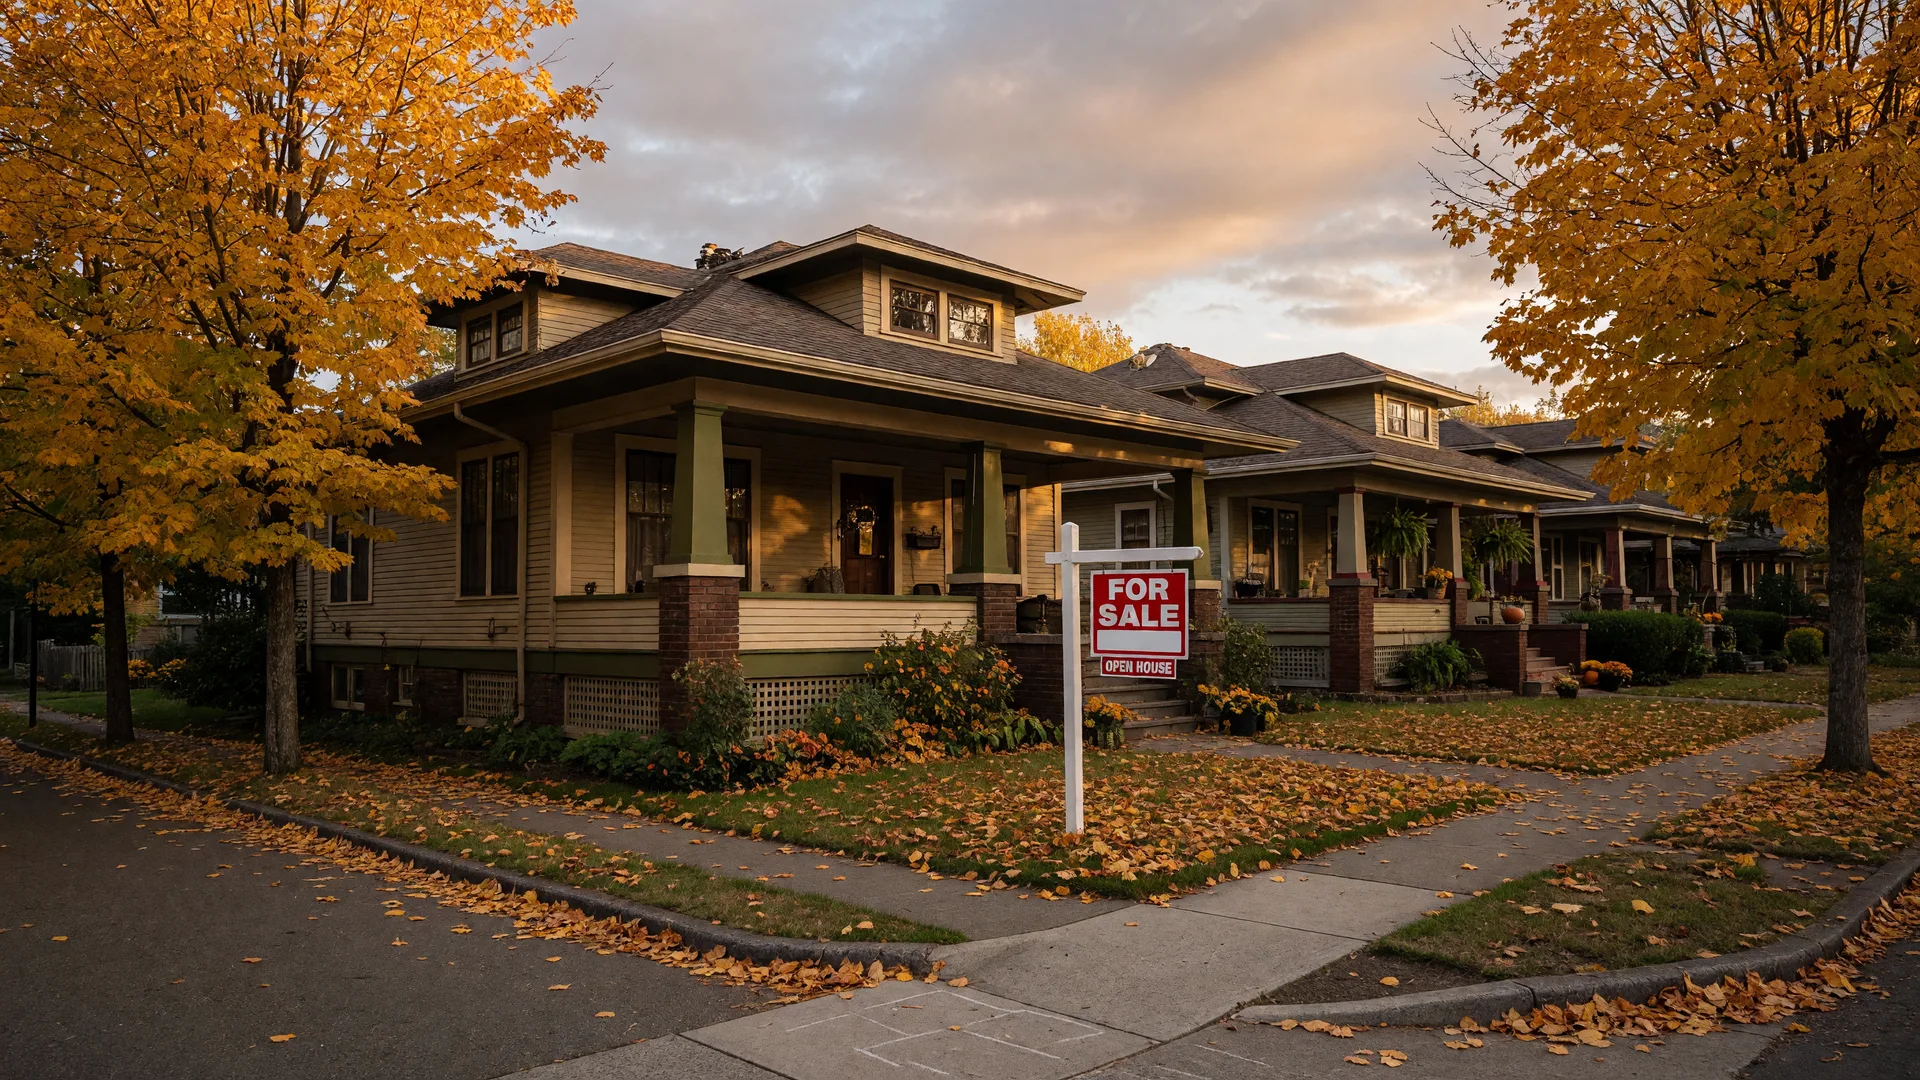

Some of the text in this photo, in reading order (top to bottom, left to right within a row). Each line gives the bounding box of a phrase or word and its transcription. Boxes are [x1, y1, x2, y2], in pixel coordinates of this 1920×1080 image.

[1108, 577, 1169, 601] FOR
[1098, 603, 1180, 627] SALE
[1105, 660, 1172, 675] OPEN HOUSE
